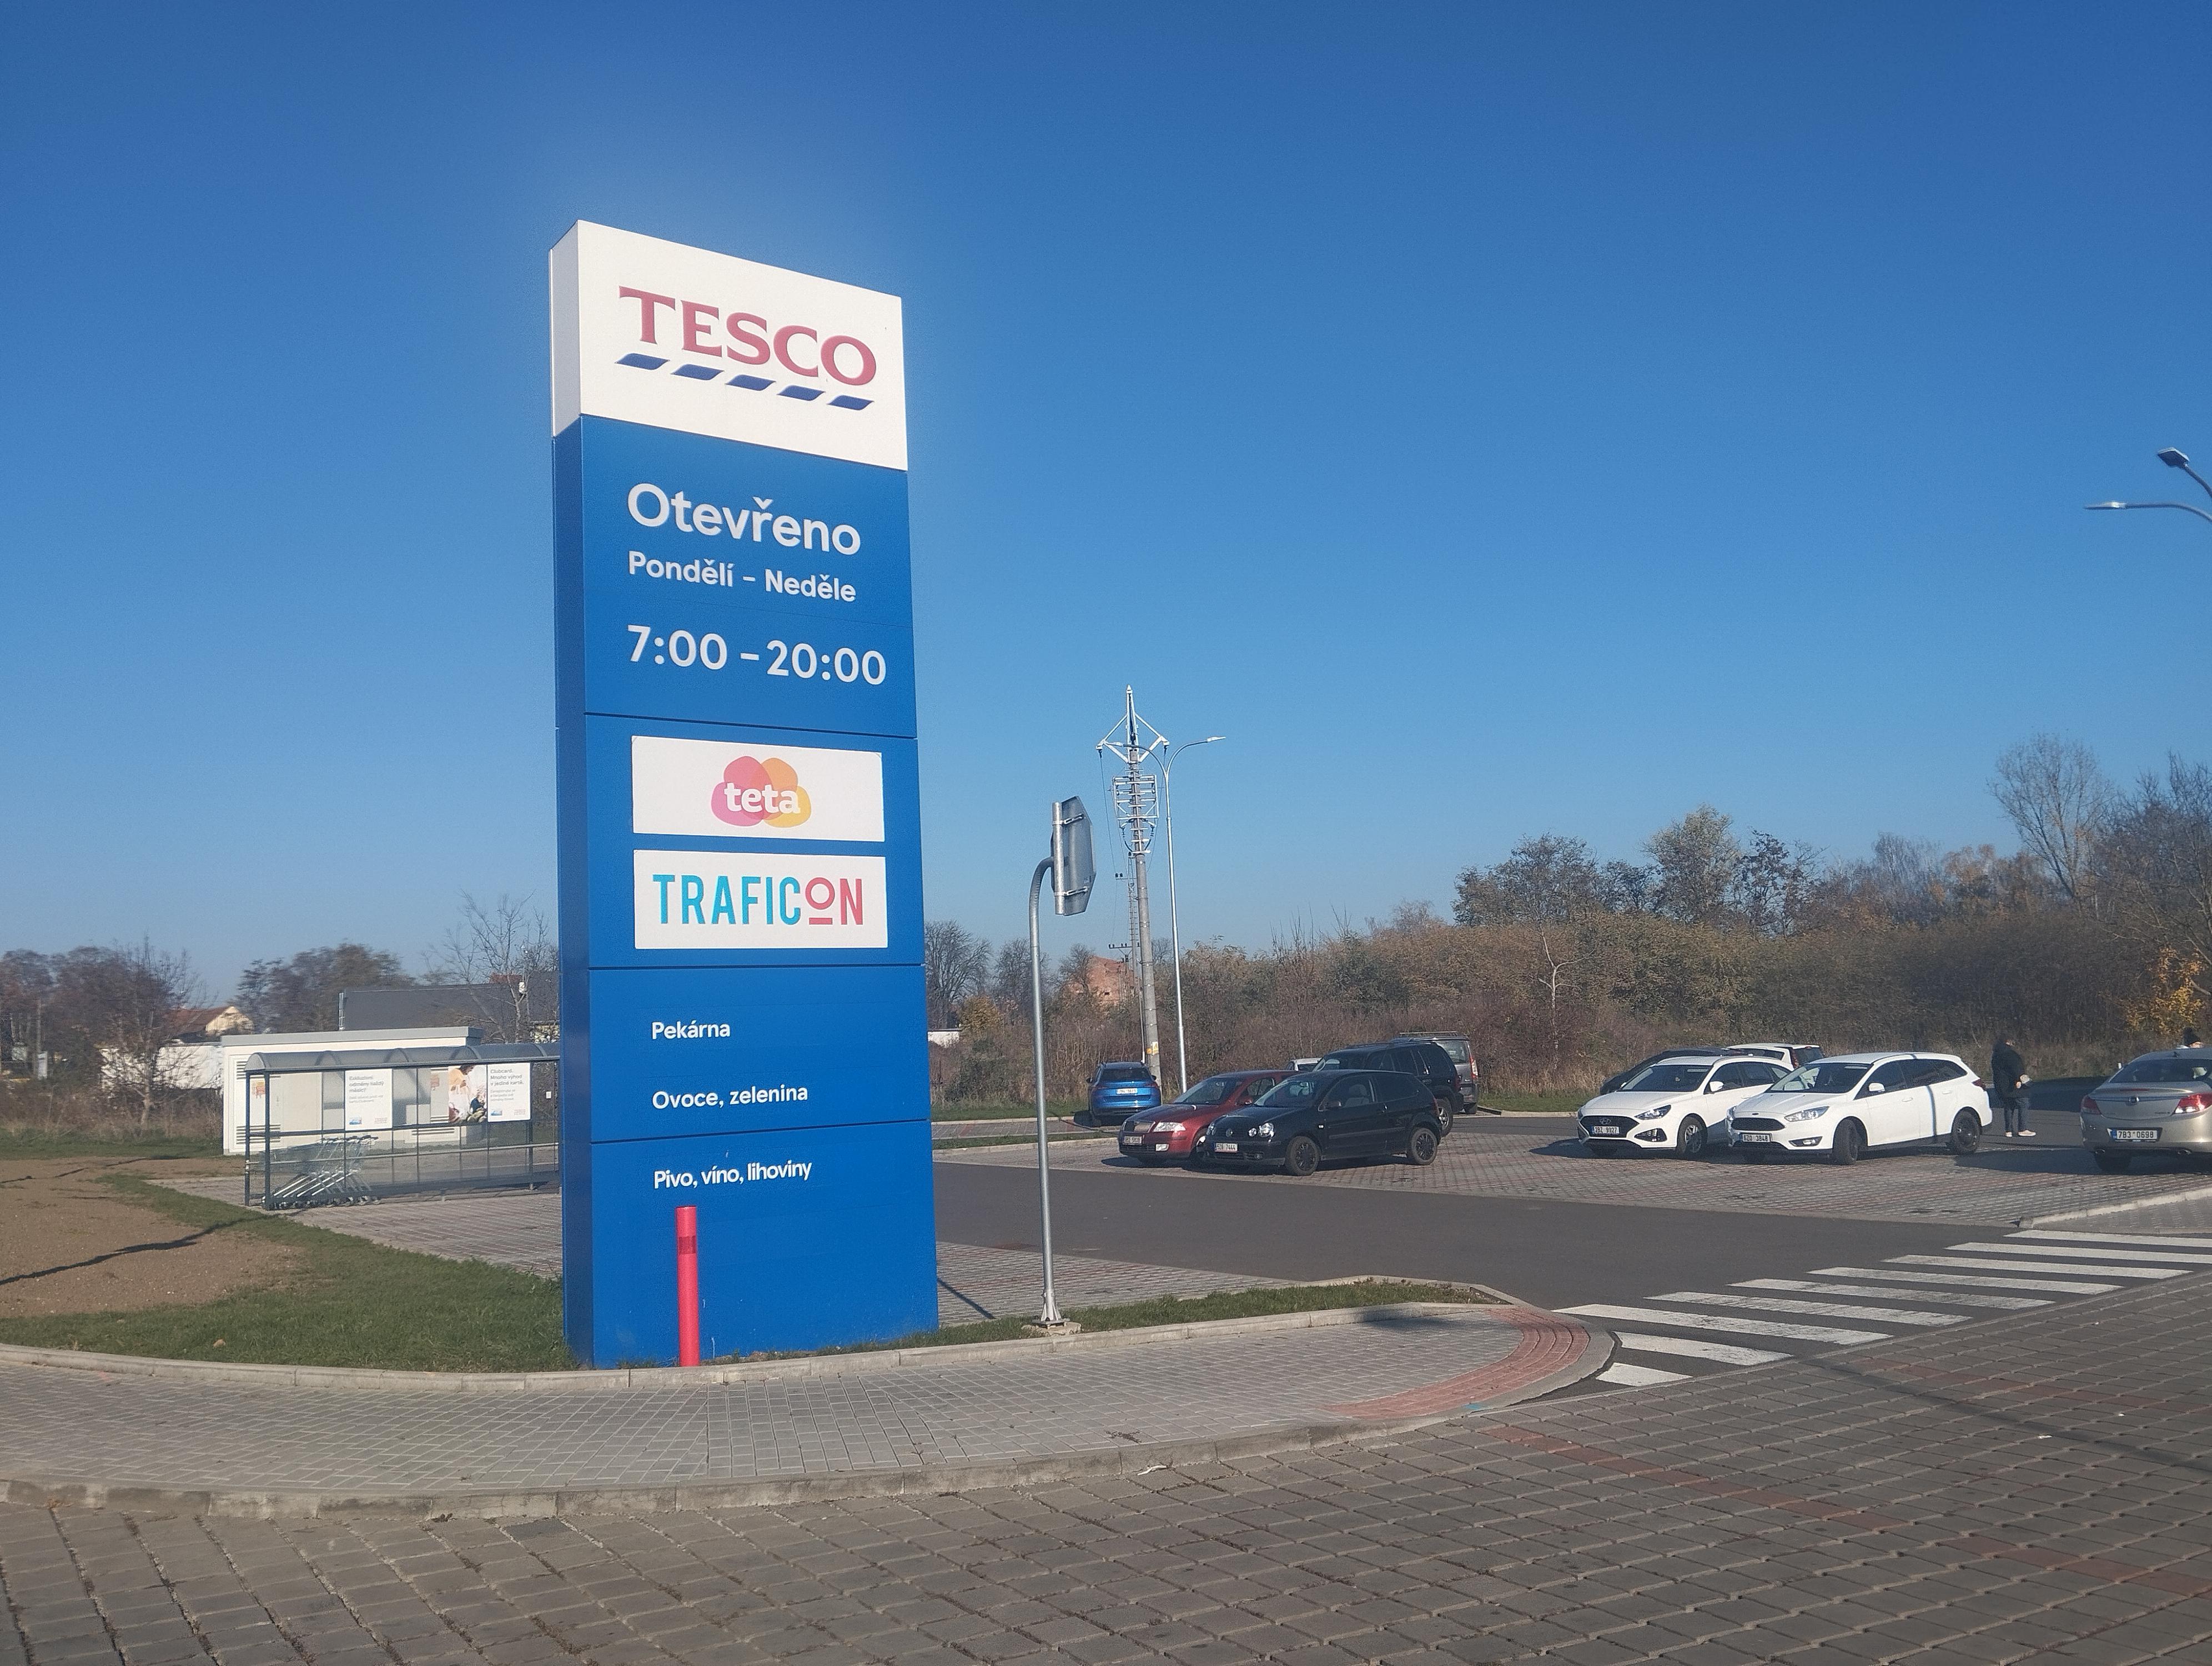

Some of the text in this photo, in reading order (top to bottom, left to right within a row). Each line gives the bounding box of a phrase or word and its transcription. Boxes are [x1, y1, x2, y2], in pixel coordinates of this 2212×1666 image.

[619, 285, 877, 386] TESCO
[627, 483, 861, 555] Otevřeno
[629, 550, 733, 587] Pondělí
[765, 568, 856, 602] Neděle
[627, 624, 727, 670] 7:00
[723, 782, 801, 815] teta
[652, 874, 863, 926] TRAFICON
[652, 1020, 730, 1040] Pekárna
[652, 1084, 808, 1110] Ovoce, zelenina
[654, 1160, 812, 1189] Pivo, víno, lihoviny
